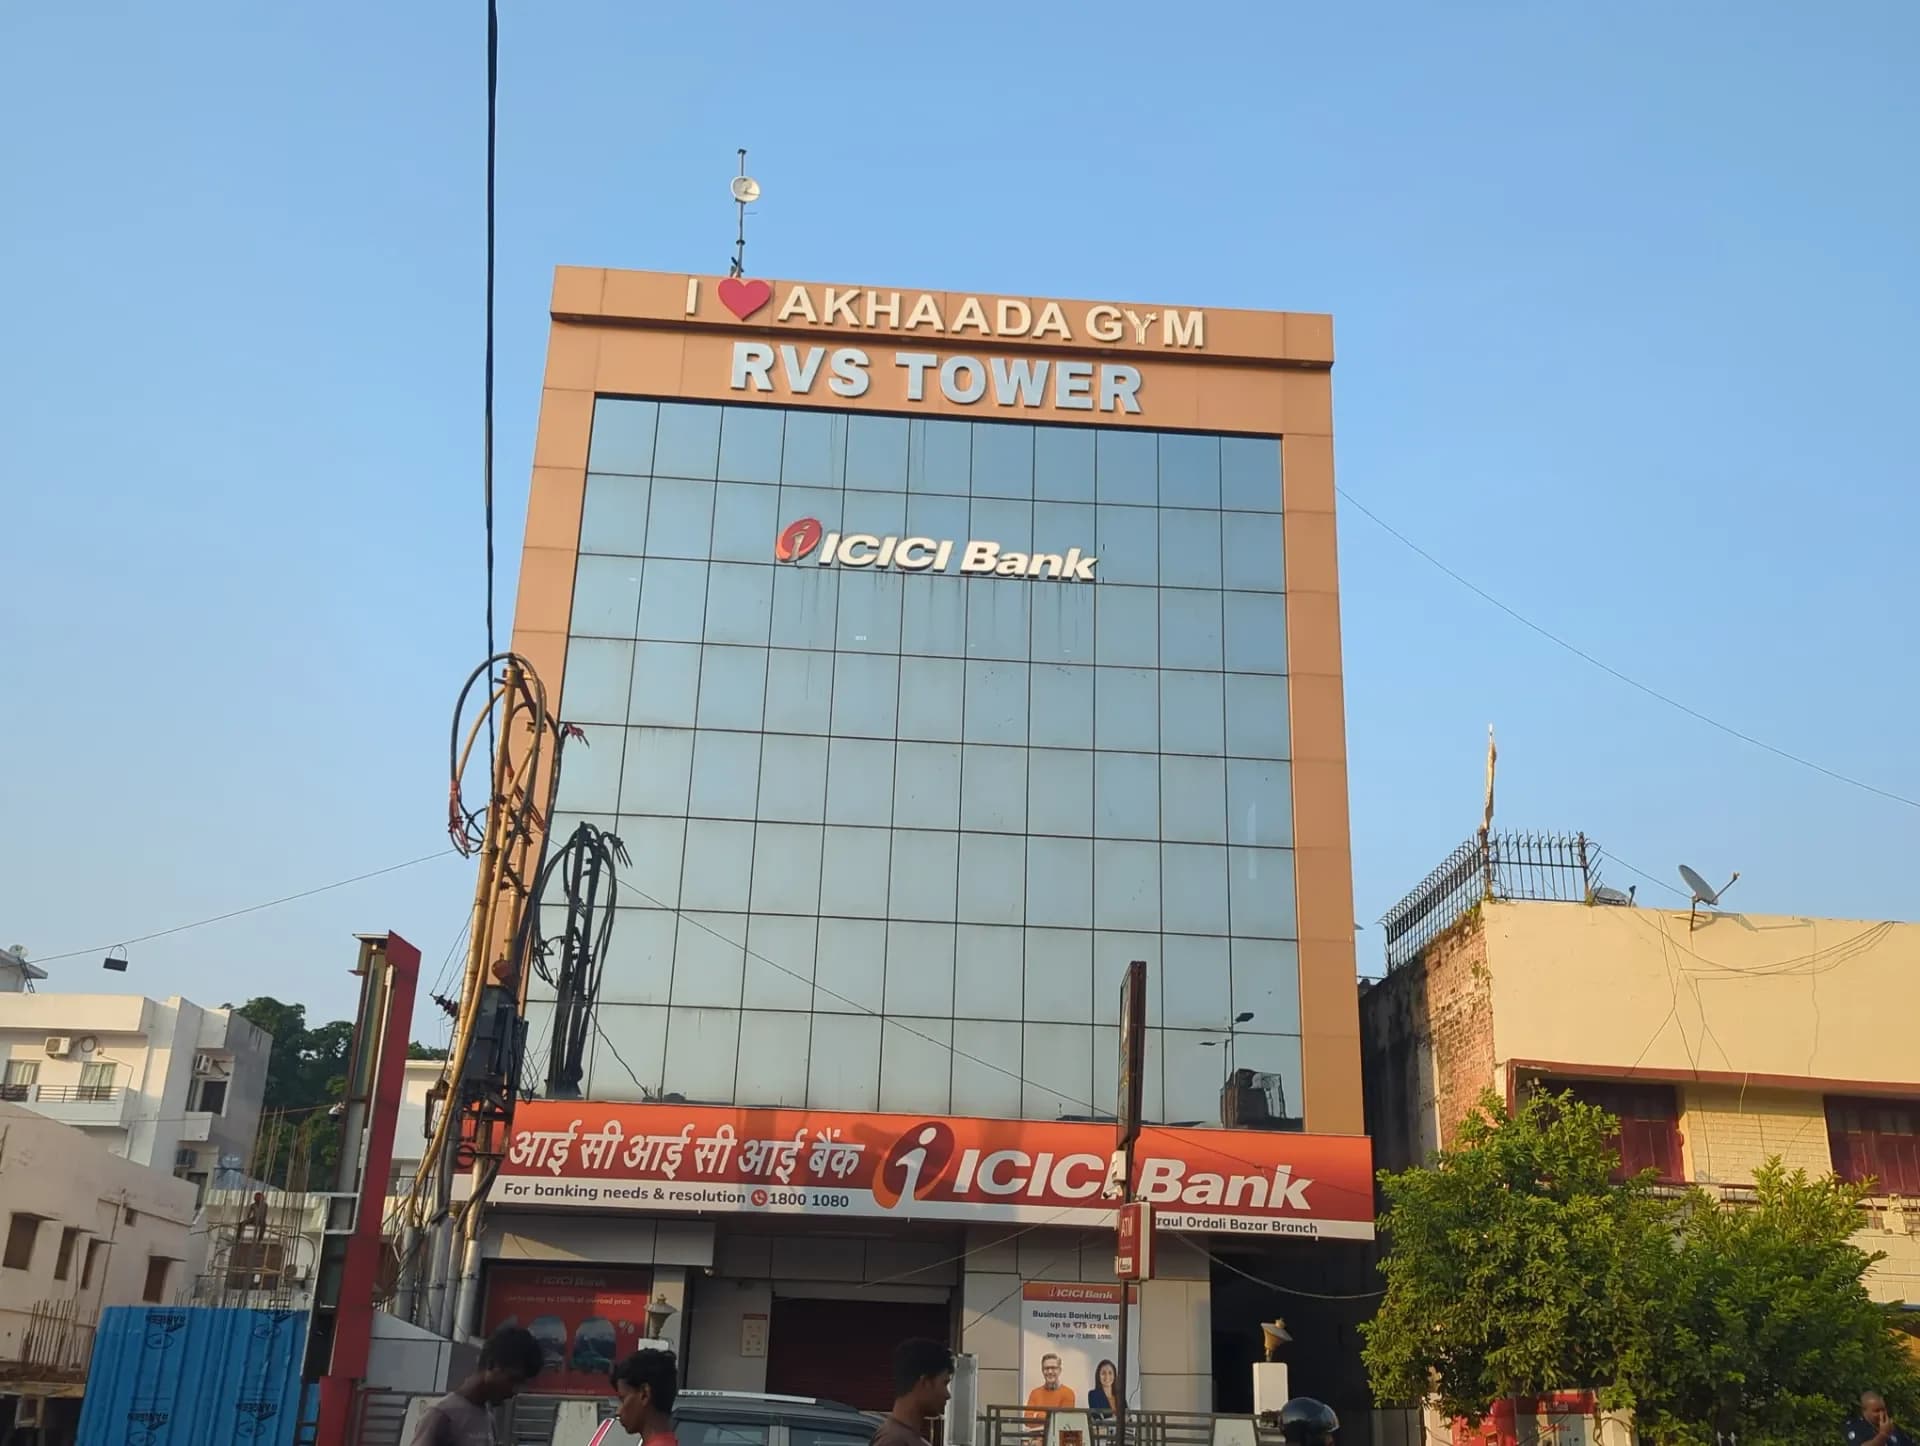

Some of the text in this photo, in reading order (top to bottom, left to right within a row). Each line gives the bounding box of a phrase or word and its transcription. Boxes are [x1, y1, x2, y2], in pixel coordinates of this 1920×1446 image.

[686, 278, 1204, 349] I AKHAADA GYM
[731, 341, 1142, 414] RVS TOWER
[818, 532, 1099, 581] ICICI Bank
[509, 1120, 866, 1184] आई सी आई सी आई बैंक
[504, 1182, 849, 1208] For banking needs & resolution 1800 1080
[1136, 1157, 1314, 1210] Bank
[1156, 1215, 1318, 1234] raul Ordali Bazar Branch
[1032, 1310, 1067, 1319] Business
[1068, 1311, 1101, 1321] Banking
[1056, 1287, 1113, 1300] ICICI Bank
